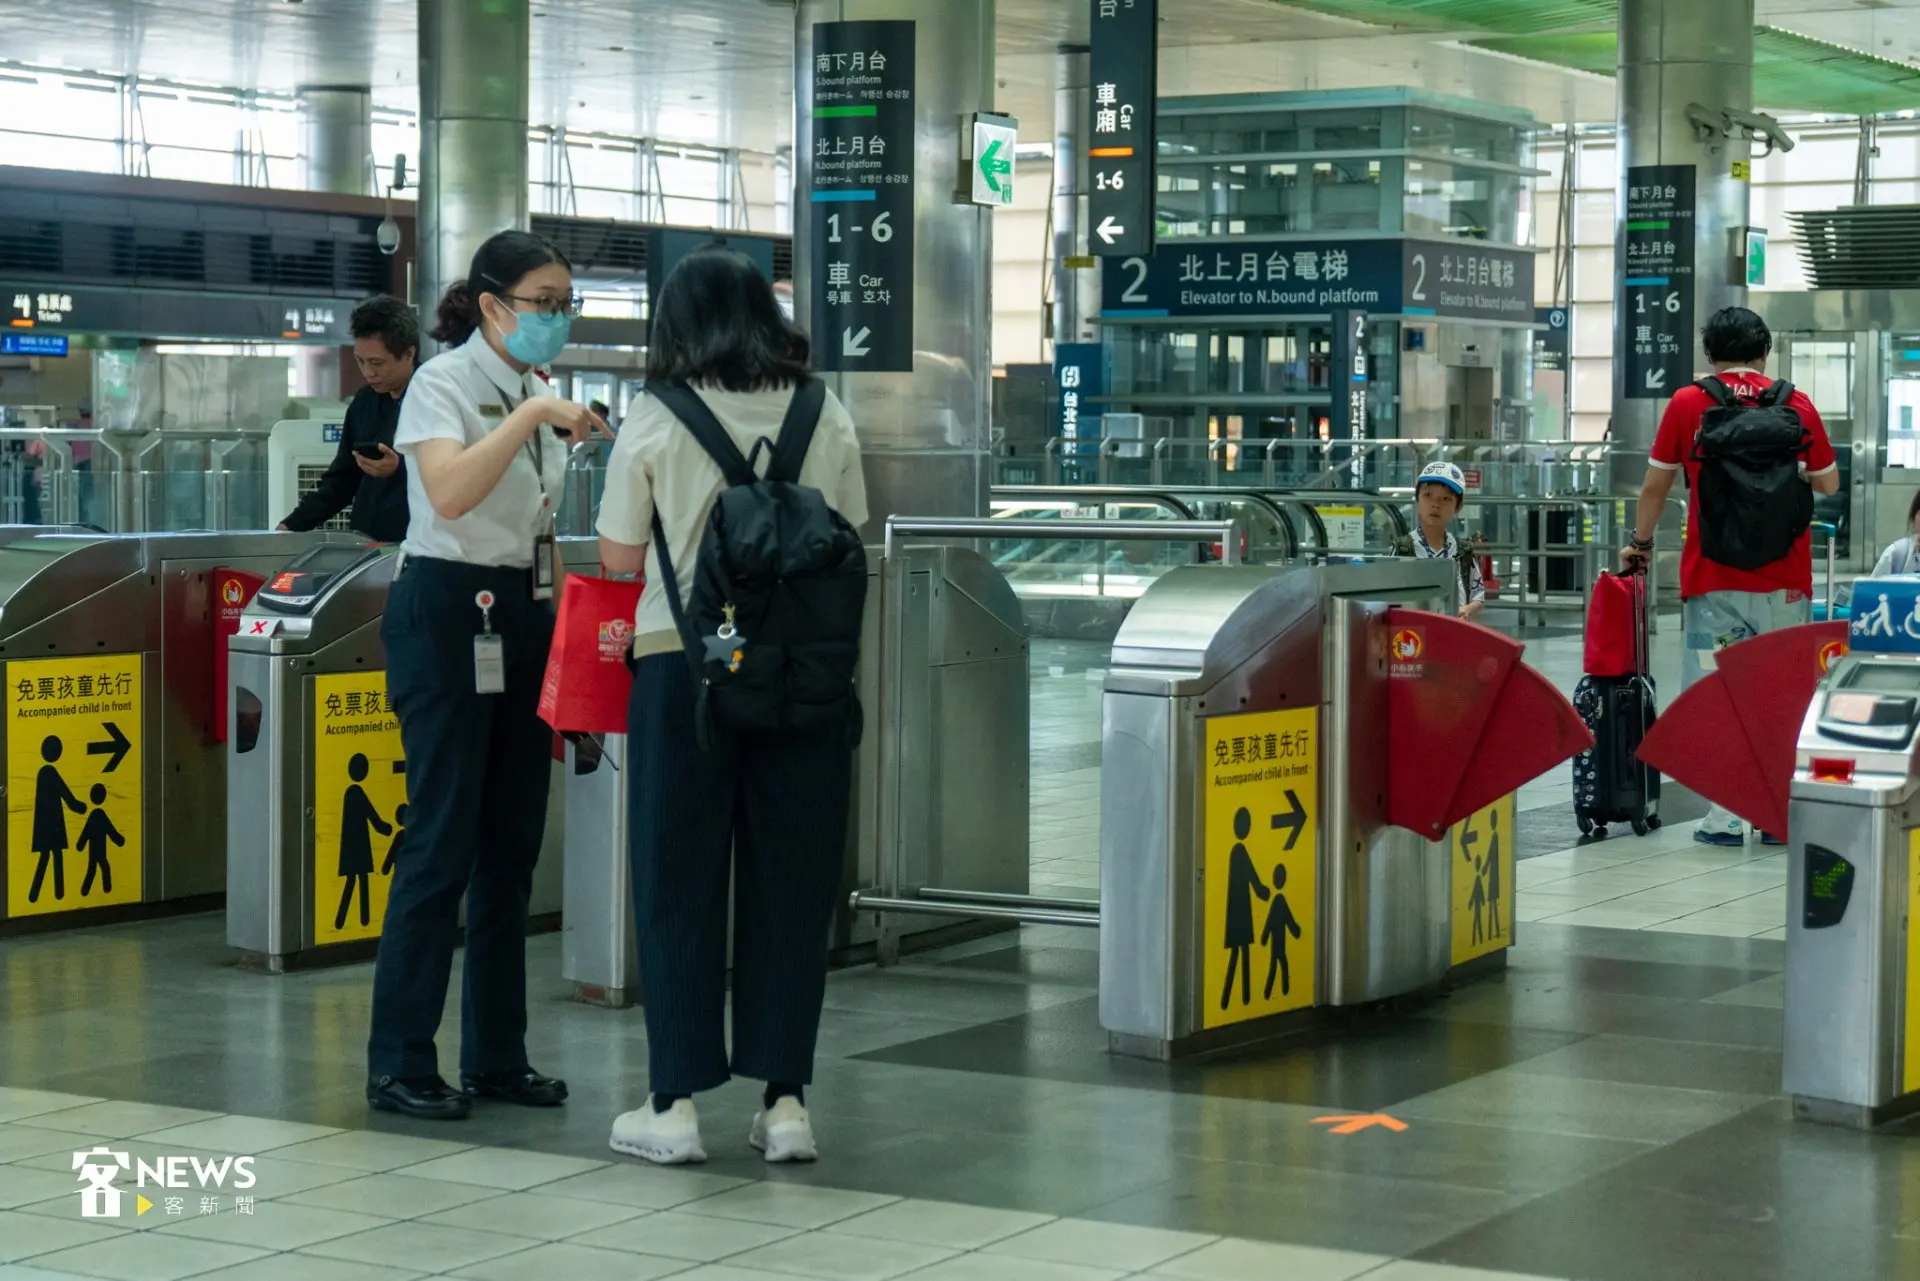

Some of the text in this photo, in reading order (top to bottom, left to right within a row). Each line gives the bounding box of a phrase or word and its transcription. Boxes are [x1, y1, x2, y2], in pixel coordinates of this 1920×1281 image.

[816, 50, 887, 73] 南下月台
[815, 75, 882, 87] S.bound platform
[1095, 82, 1117, 133] 車廂
[1120, 104, 1134, 130] Car
[815, 134, 886, 156] 北上月台
[846, 159, 882, 170] platform
[1096, 170, 1124, 190] 1-6
[1629, 184, 1677, 200] 南下月台
[1628, 241, 1676, 256] 北上月台
[827, 261, 852, 289] 車
[1179, 249, 1349, 282] 北上月台電梯
[1439, 255, 1515, 288] 北上月台電梯
[859, 274, 884, 287] Car
[1121, 256, 1149, 303] 2
[1412, 253, 1427, 301] 2
[826, 290, 852, 305] 号車
[861, 289, 892, 306] 호차
[1180, 287, 1379, 306] Elevator to N.bound platform
[1355, 315, 1364, 338] 2
[1635, 324, 1652, 344] 車
[1656, 333, 1674, 343] Car
[17, 672, 132, 702] 免票孩童先行
[17, 700, 132, 719] Accompanied child in front
[325, 719, 401, 736] Accompanied chil
[1214, 729, 1309, 767] 免票孩童先行
[1214, 763, 1308, 787] Accompanied child in front
